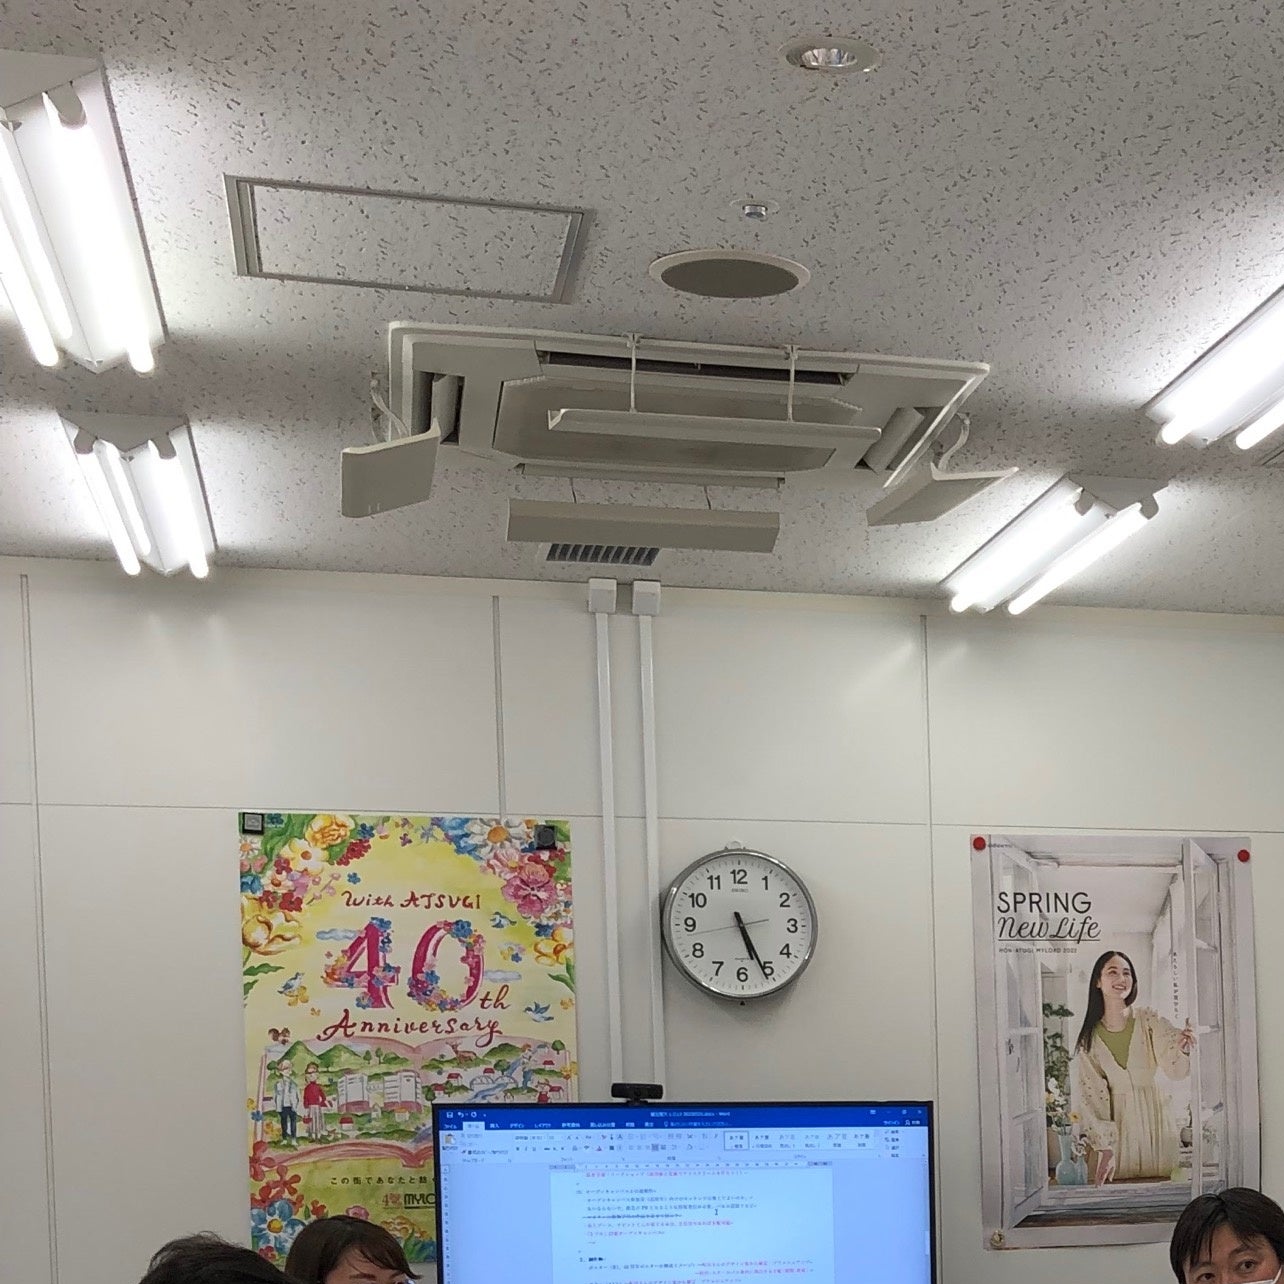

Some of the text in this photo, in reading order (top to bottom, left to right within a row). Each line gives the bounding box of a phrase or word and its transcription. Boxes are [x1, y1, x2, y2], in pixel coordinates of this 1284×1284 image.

[706, 874, 722, 891] 11
[729, 868, 749, 885] 12
[761, 875, 770, 891] 1
[341, 890, 395, 908] With
[688, 892, 708, 909] 10
[779, 892, 791, 908] 2
[997, 891, 1092, 914] SPRING
[683, 916, 697, 933] 9
[786, 918, 799, 934] 3
[997, 915, 1102, 944] New Life
[691, 942, 705, 959] 8
[779, 943, 793, 959] 4
[321, 917, 512, 1013] 40 th
[711, 960, 725, 977] 7
[762, 960, 776, 978] 5
[736, 966, 749, 983] 6
[316, 1009, 504, 1048] Anniversary
